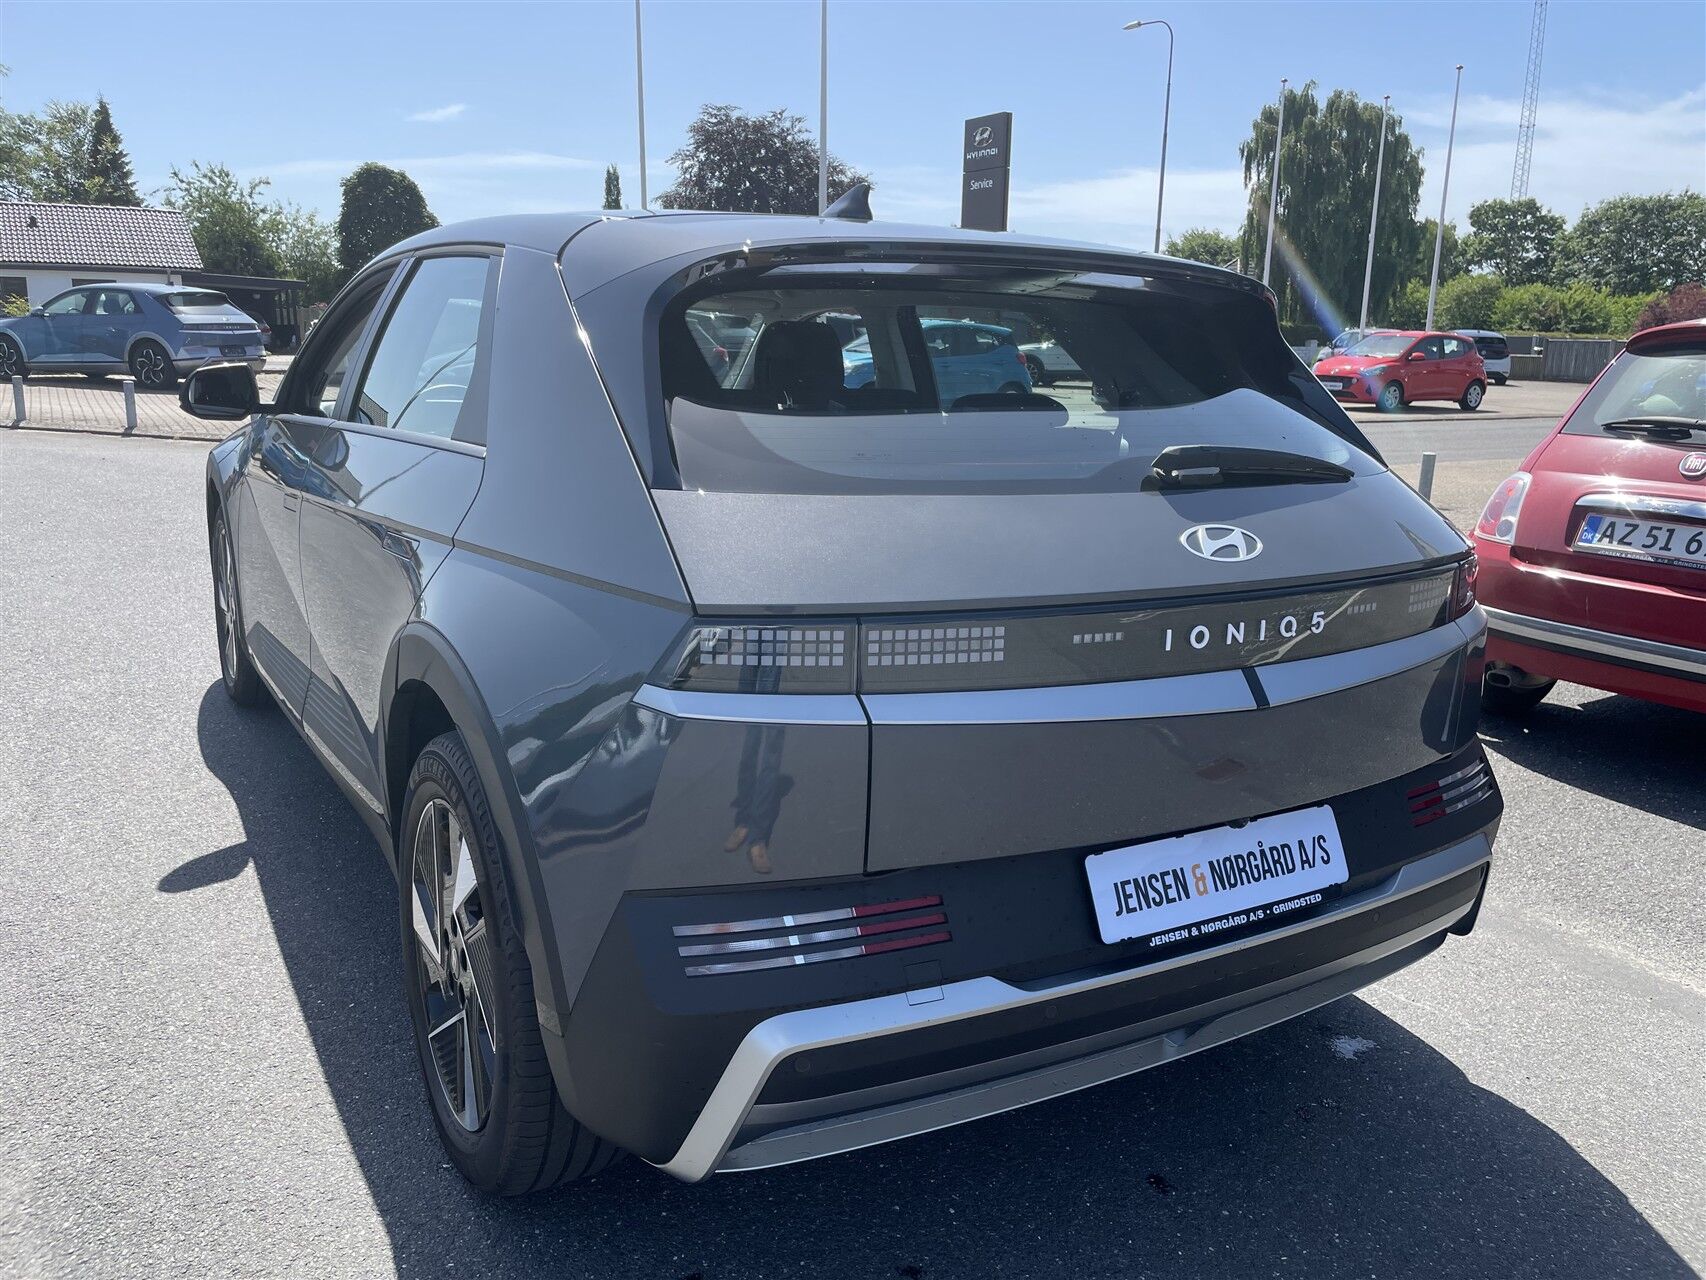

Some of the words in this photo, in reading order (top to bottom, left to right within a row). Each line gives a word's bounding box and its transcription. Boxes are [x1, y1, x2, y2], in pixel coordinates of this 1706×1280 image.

[966, 147, 998, 159] HYUNDAI
[970, 178, 993, 190] Service
[1685, 457, 1706, 470] FIAT
[1582, 531, 1593, 541] DK
[1597, 521, 1639, 546] AZ
[1641, 525, 1676, 552] 51
[1685, 530, 1706, 557] 6
[1113, 867, 1191, 917] JENSEN
[1190, 863, 1209, 897] &
[1207, 841, 1296, 893] NØRGÅRD
[1297, 834, 1331, 871] A/S
[1149, 929, 1189, 947] JENSEN
[1191, 926, 1200, 937] &
[1200, 914, 1247, 934] NØRGÅRD
[1249, 910, 1265, 922] A/S
[1272, 893, 1322, 915] GRINDSTED
